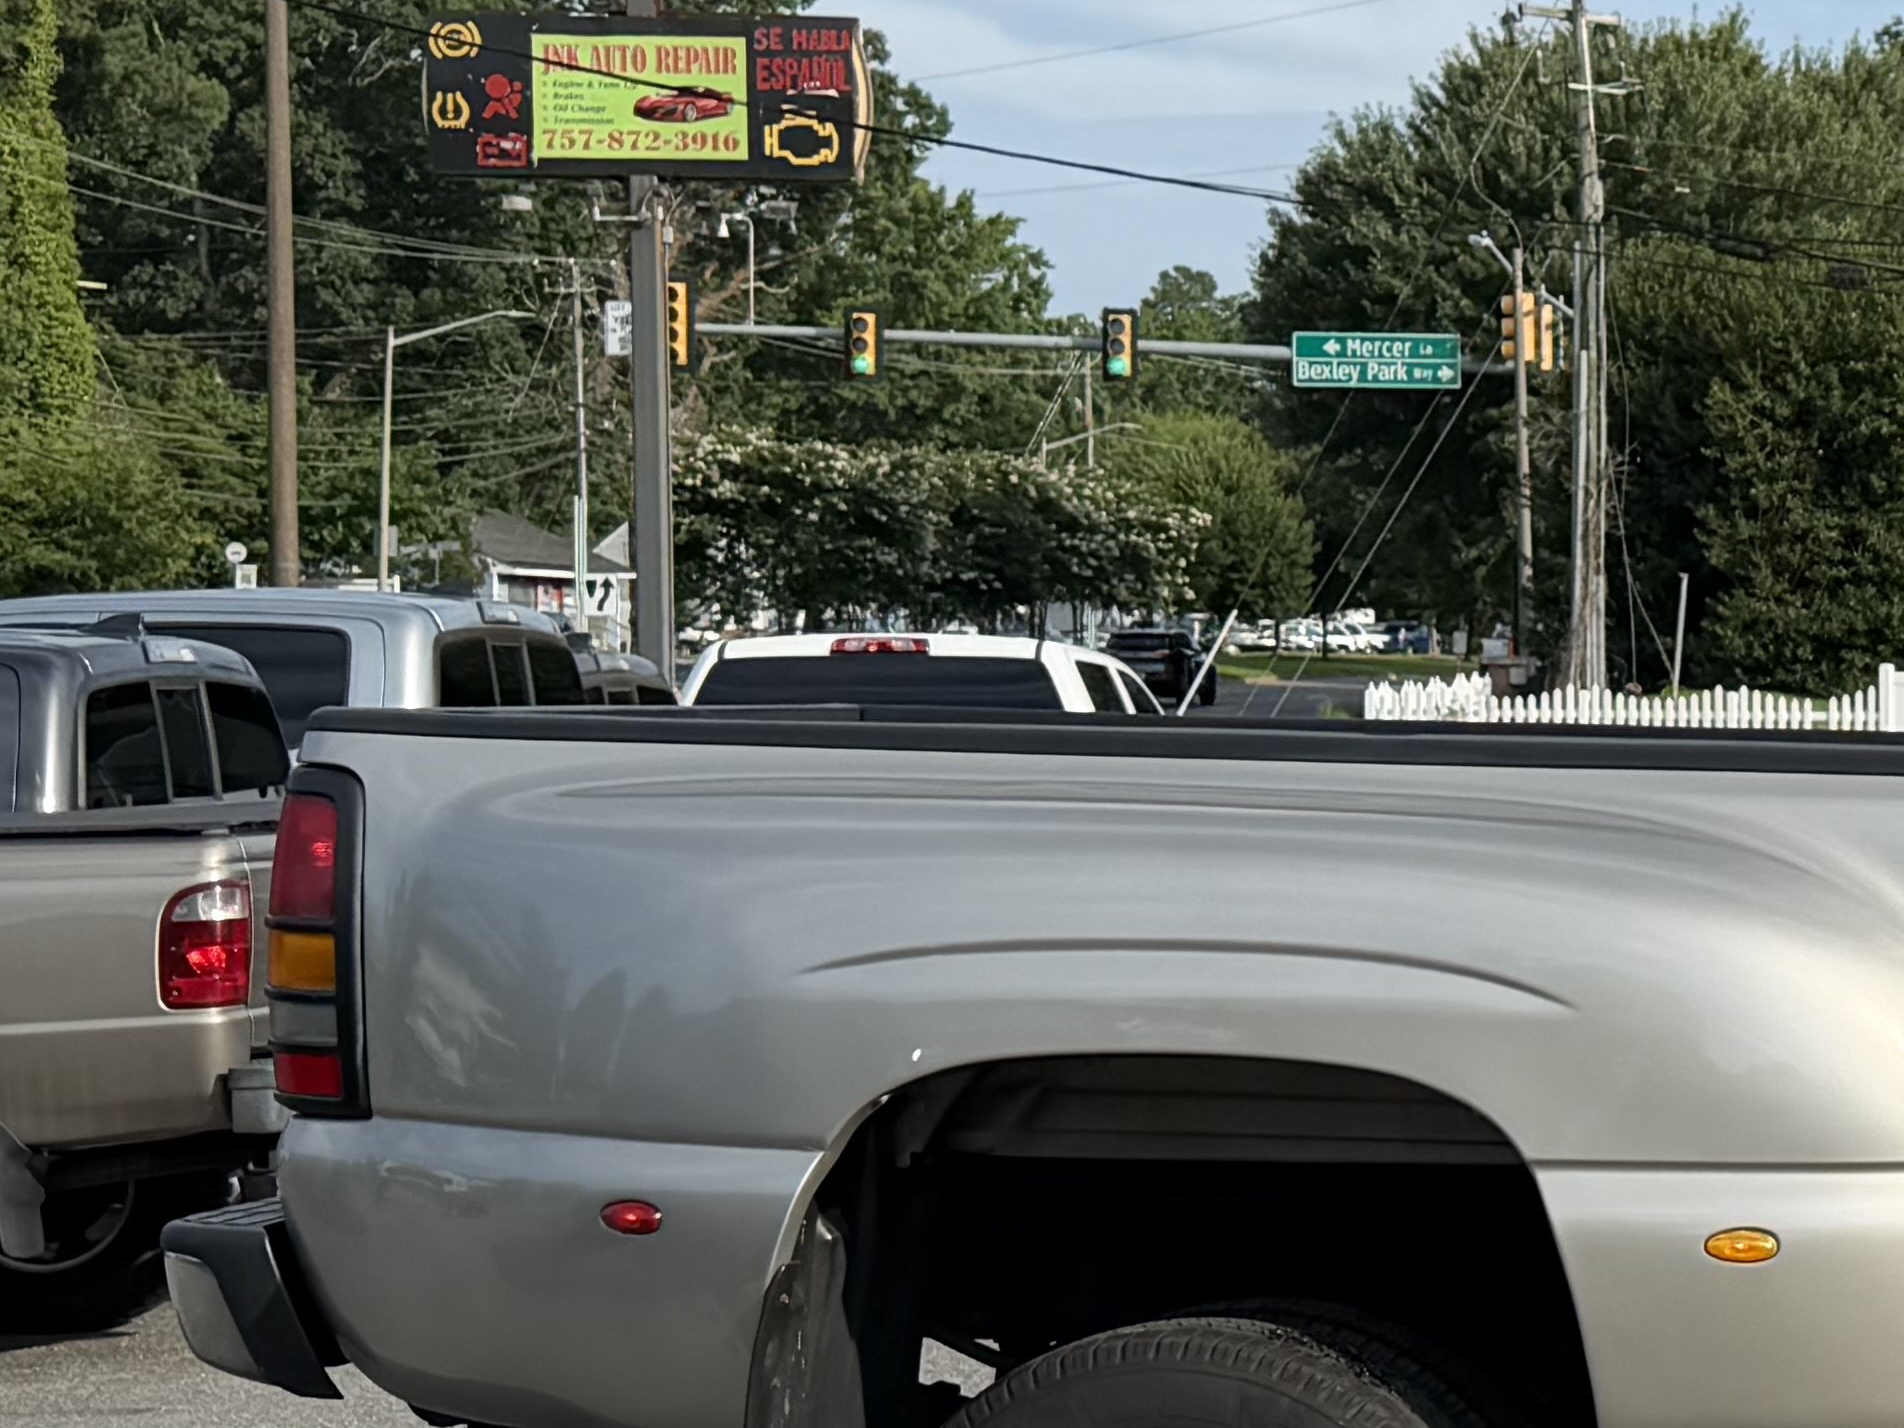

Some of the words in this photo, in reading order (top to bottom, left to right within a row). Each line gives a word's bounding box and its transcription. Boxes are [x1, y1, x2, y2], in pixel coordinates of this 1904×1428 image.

[753, 27, 784, 51] SE
[792, 28, 851, 51] HABLA
[591, 44, 648, 74] AUTO
[654, 45, 738, 75] REPAIR
[542, 128, 741, 153] 757-872-3916
[1346, 338, 1412, 358] Mercer
[1298, 361, 1361, 385] Bexley
[1367, 361, 1408, 381] Park
